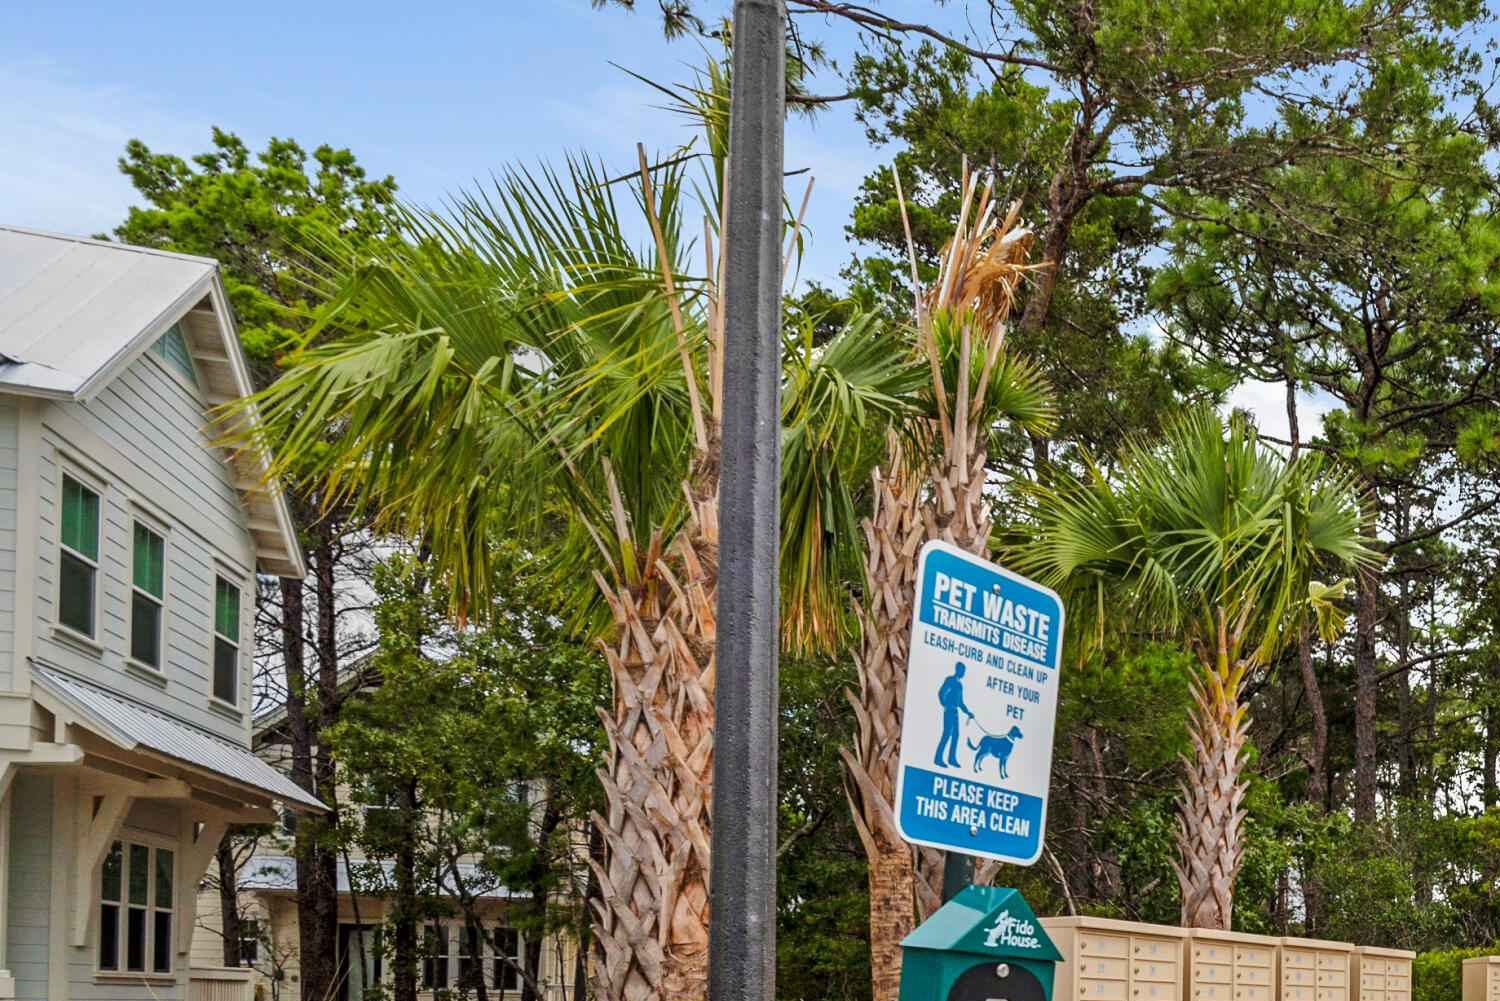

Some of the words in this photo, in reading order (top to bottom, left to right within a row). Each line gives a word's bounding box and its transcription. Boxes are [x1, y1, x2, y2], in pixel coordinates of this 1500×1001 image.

[933, 571, 977, 612] PET
[983, 588, 1050, 642] WASTE
[932, 605, 1000, 645] TRANSMITS
[1002, 632, 1047, 662] DISEASE
[924, 630, 984, 663] LEASH-CURB
[986, 653, 1005, 670] AND
[1006, 659, 1034, 680] CLEAN
[1036, 670, 1048, 684] UP
[986, 675, 1015, 696] AFTER
[1017, 685, 1040, 704] YOUR
[1006, 703, 1025, 721] PET
[933, 776, 984, 806] PLEASE
[987, 789, 1019, 812] KEEP
[915, 796, 948, 821] THIS
[951, 804, 986, 829] AREA
[990, 812, 1030, 837] CLEAN
[1007, 917, 1034, 936] Fido
